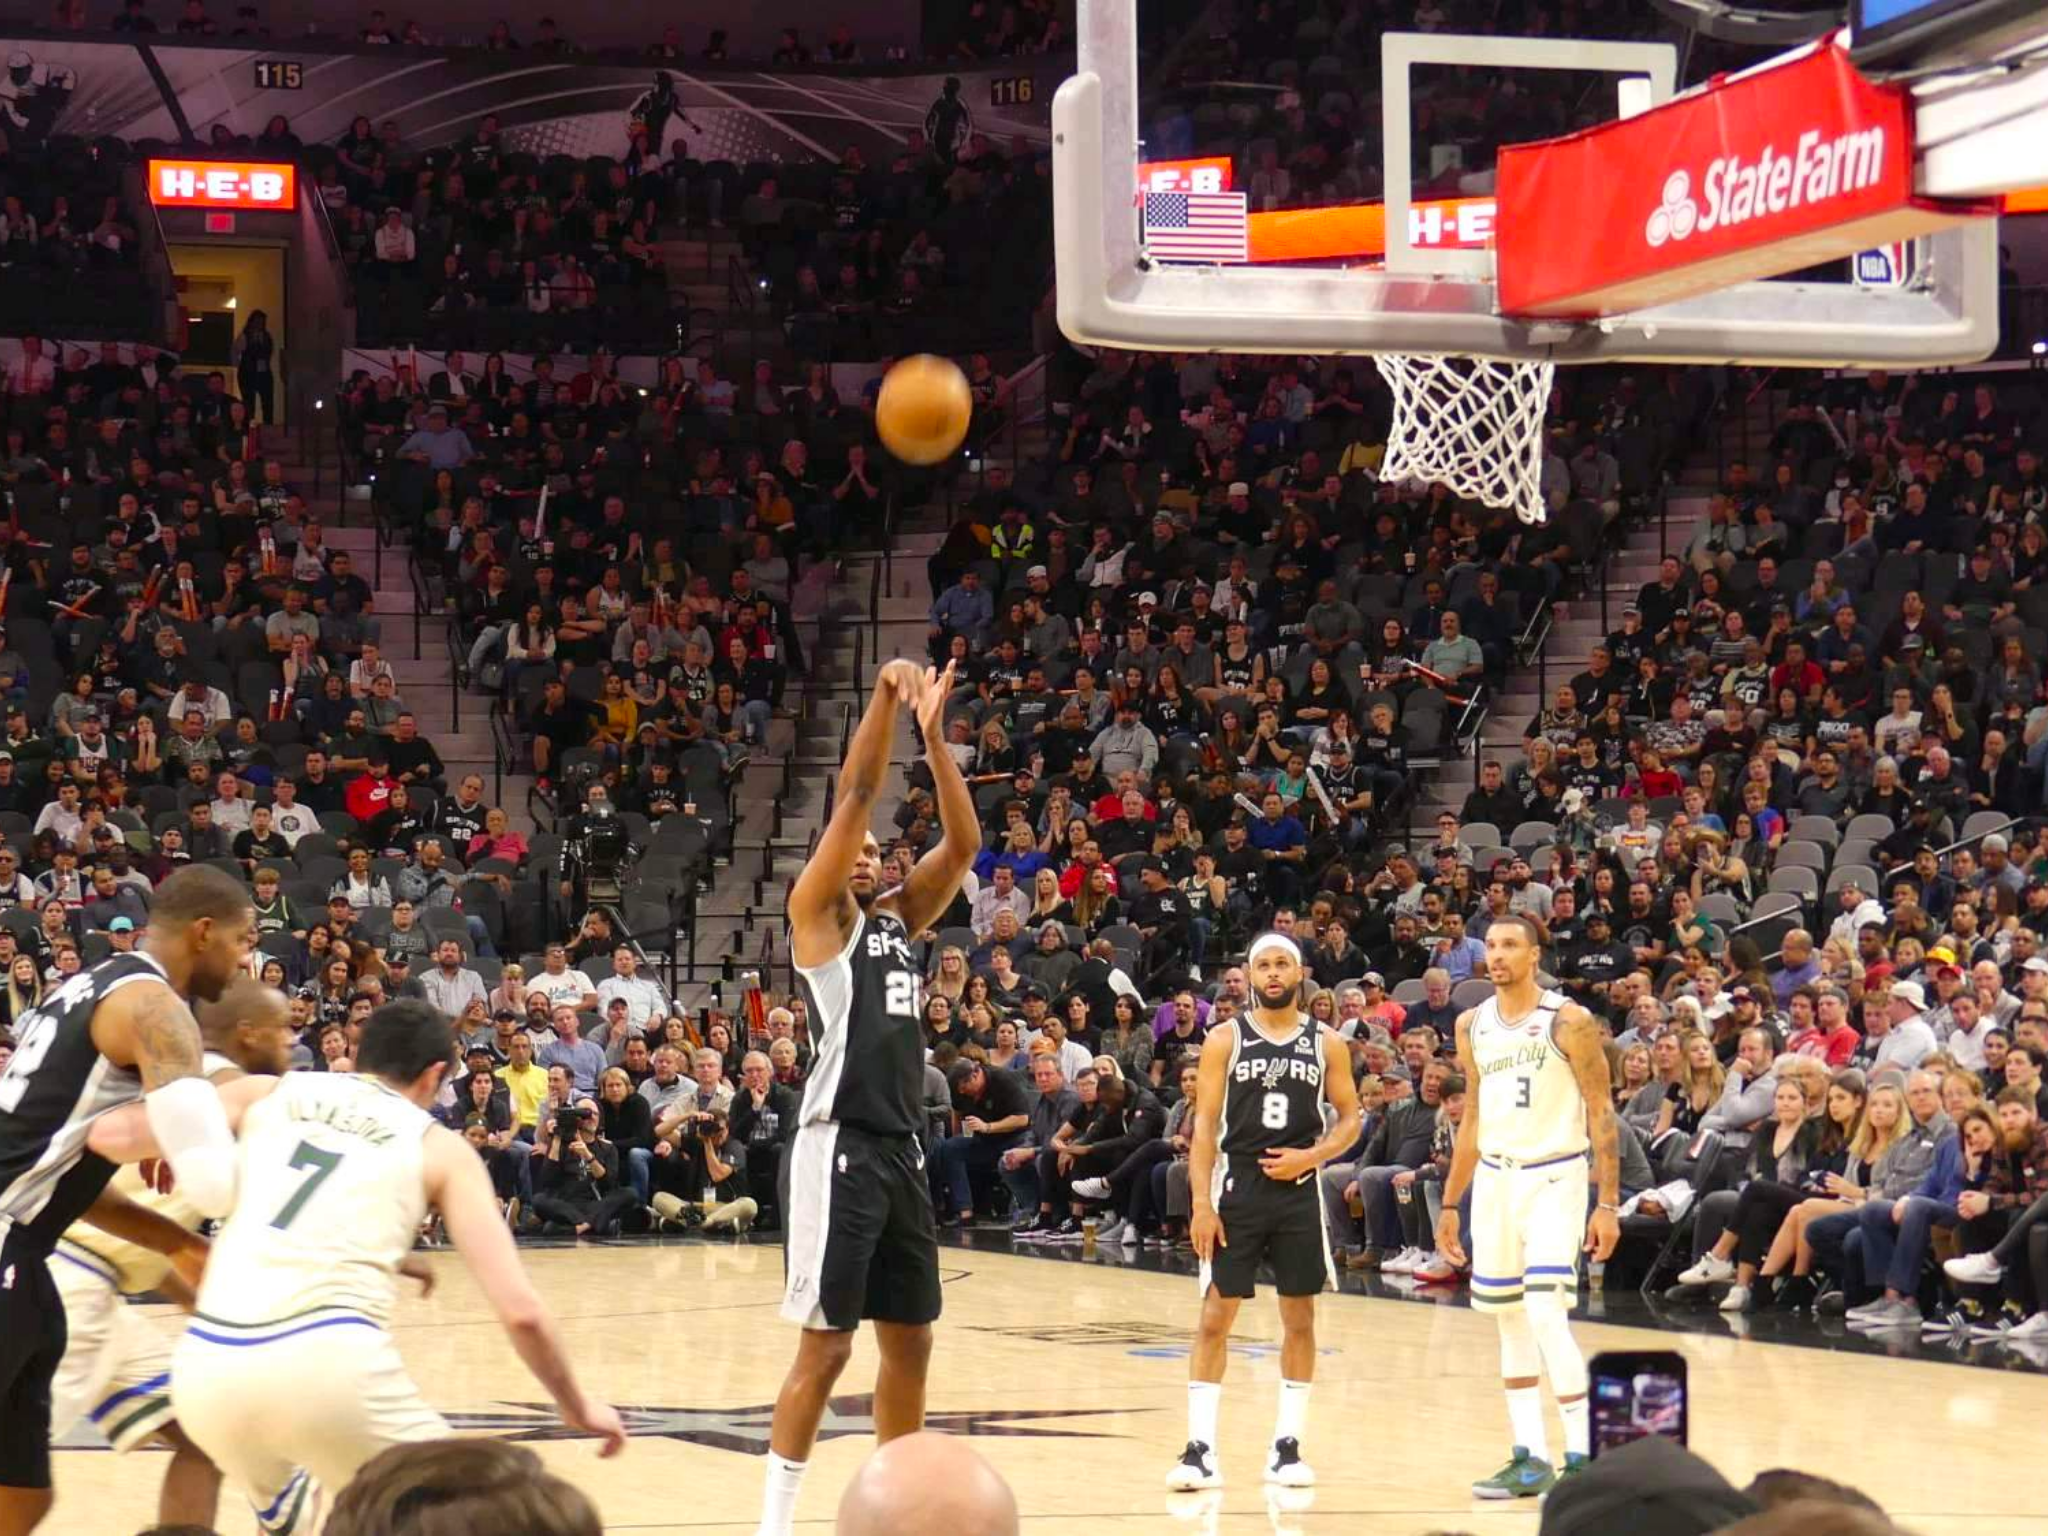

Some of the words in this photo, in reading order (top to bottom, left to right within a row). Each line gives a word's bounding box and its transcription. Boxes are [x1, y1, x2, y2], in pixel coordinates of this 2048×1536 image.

[258, 63, 300, 88] 115
[993, 79, 1031, 104] 116
[160, 168, 284, 201] H-E-B
[1860, 256, 1887, 274] NBA
[1516, 1040, 1548, 1071] City
[1235, 1057, 1320, 1090] SPURS
[1515, 1076, 1531, 1109] 3
[1261, 1091, 1289, 1130] 8
[268, 1138, 345, 1231] 7
